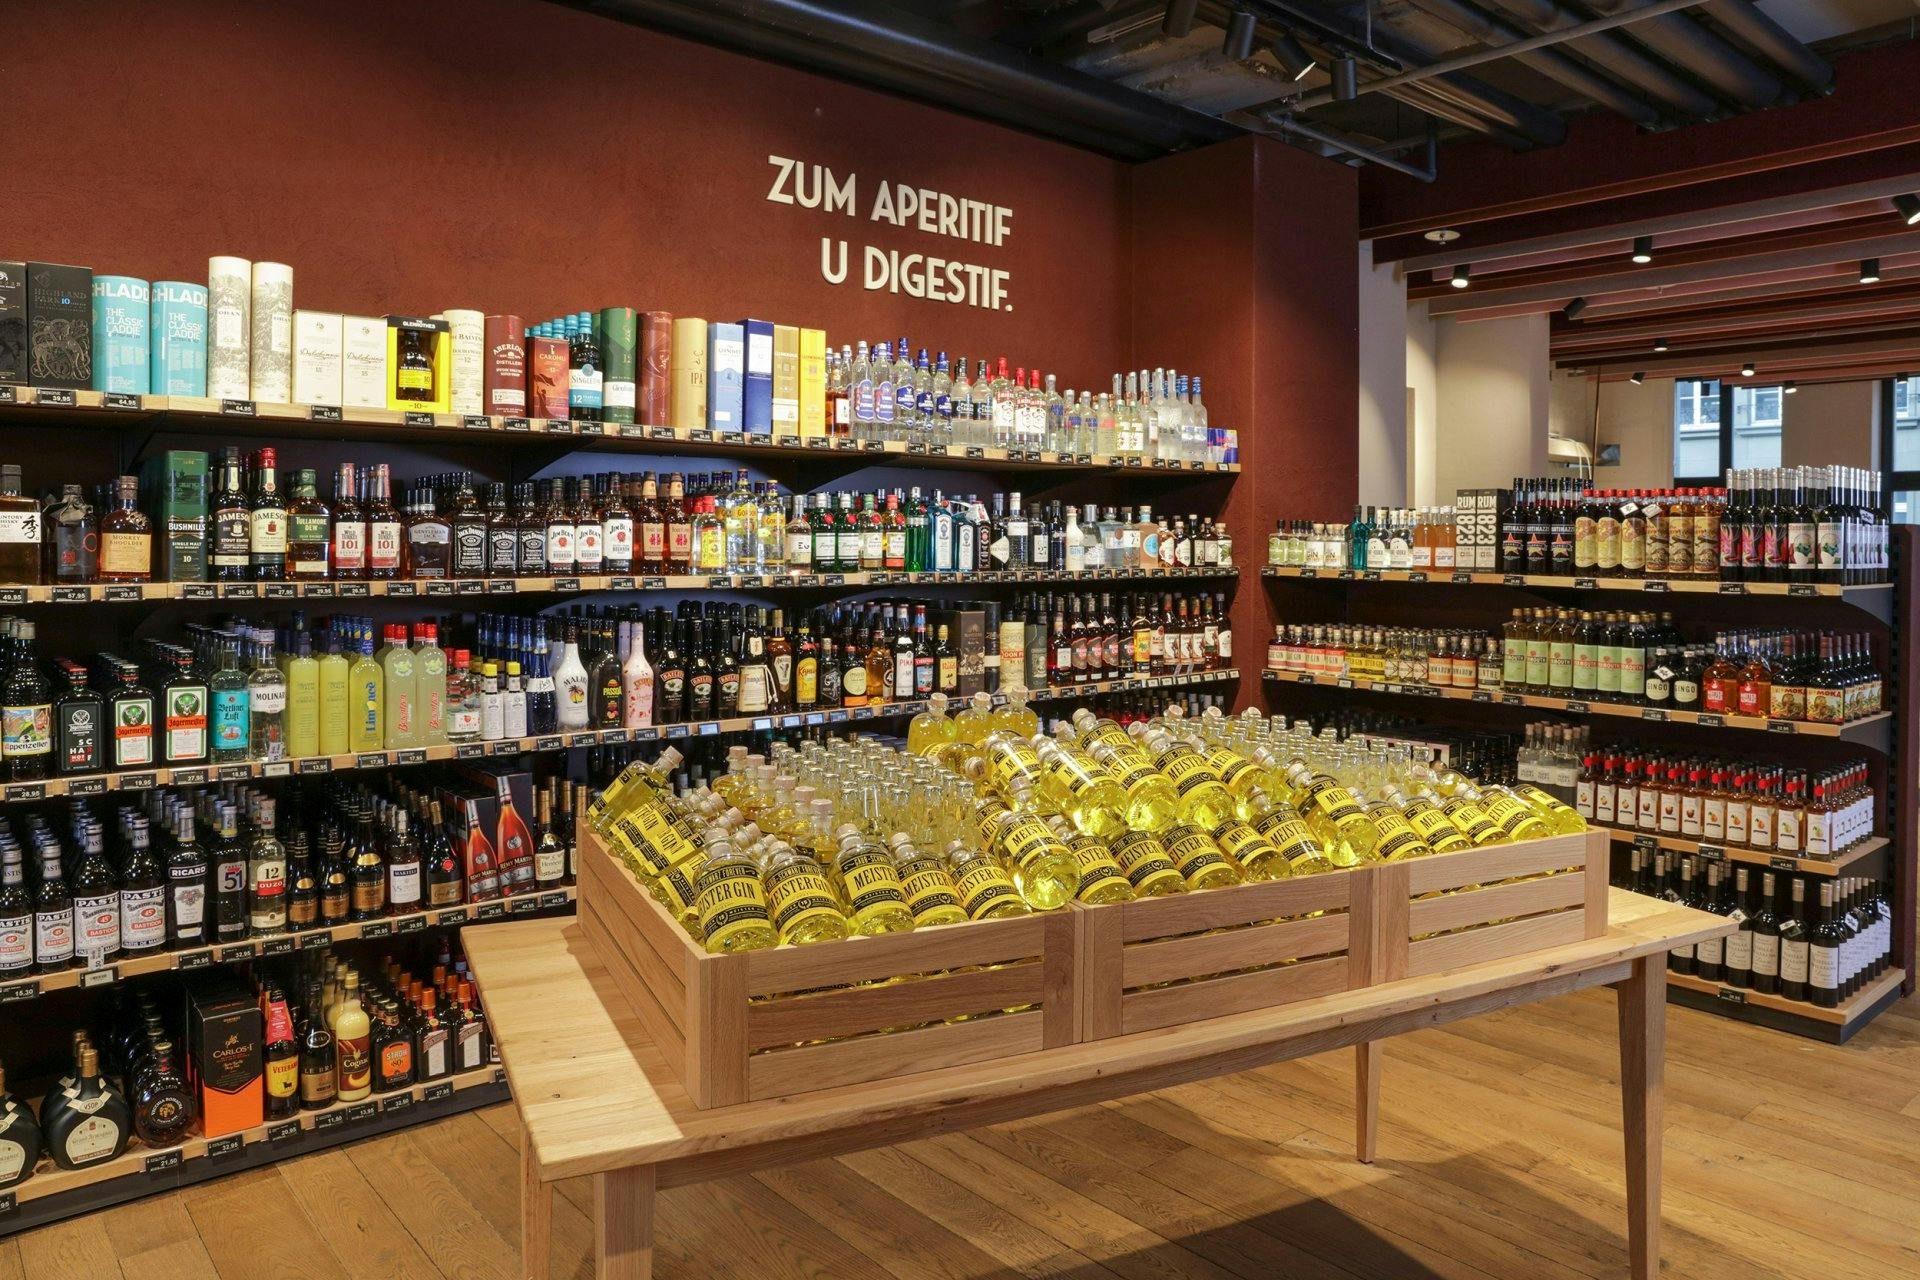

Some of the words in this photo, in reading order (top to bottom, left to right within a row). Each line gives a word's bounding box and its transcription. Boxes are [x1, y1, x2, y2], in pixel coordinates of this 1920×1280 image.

[767, 155, 856, 216] ZUM
[870, 180, 1013, 247] APERITIF
[821, 237, 848, 285] U
[864, 245, 1013, 312] DIGESTIF.
[106, 308, 125, 317] THE
[169, 313, 187, 322] THE
[1457, 496, 1475, 508] RUM
[1478, 496, 1496, 508] RUM
[341, 540, 358, 549] 101
[377, 540, 394, 549] 101
[3, 593, 22, 601] 49.95
[1816, 690, 1841, 698] MOKA
[171, 866, 206, 877] RICARD
[264, 867, 279, 880] 12
[224, 870, 243, 890] 51
[259, 881, 283, 889] OUZO
[733, 881, 756, 900] GIN
